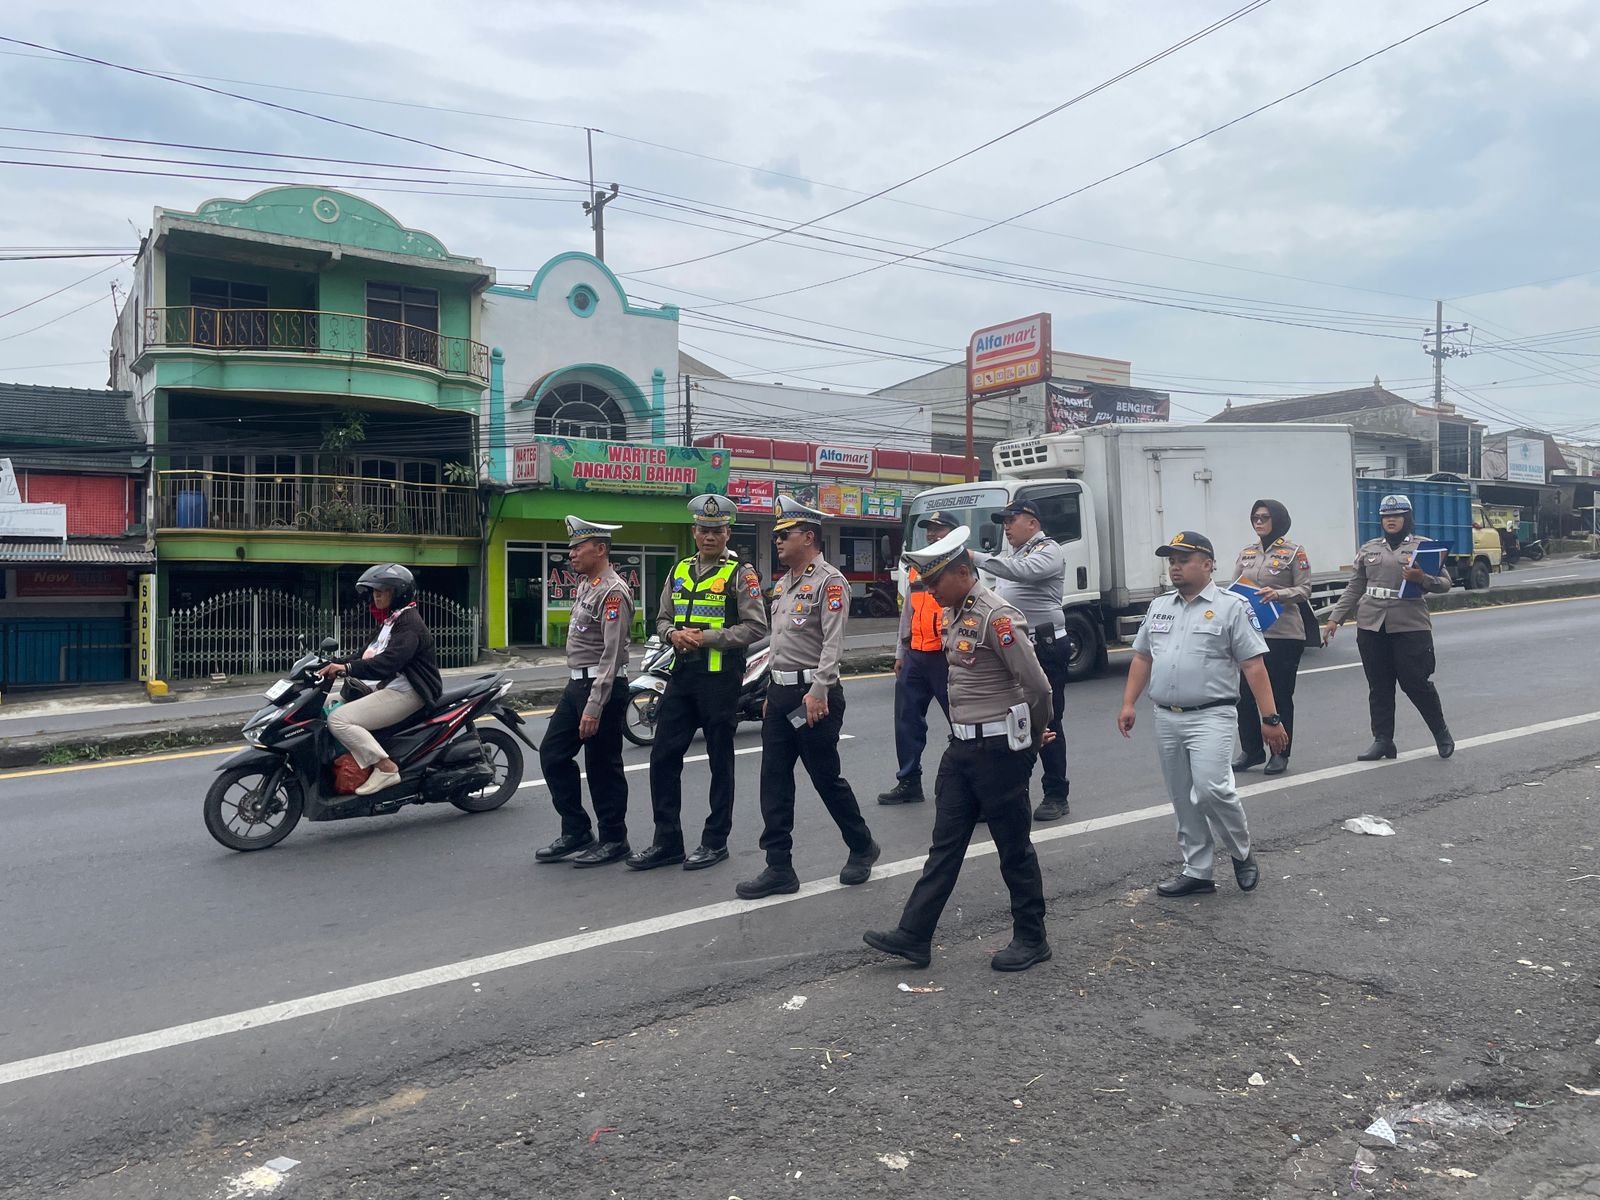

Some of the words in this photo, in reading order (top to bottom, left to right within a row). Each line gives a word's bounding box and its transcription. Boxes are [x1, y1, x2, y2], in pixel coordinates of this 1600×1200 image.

[976, 325, 1037, 353] Alfamart
[1116, 401, 1157, 415] BENGKEL
[515, 447, 537, 462] WARTEG
[607, 445, 667, 465] WARTEG
[819, 448, 870, 464] Alfamart
[524, 464, 536, 478] JAM
[572, 462, 641, 481] ANGKASA
[645, 466, 698, 484] BAHARI
[1151, 613, 1176, 621] FEBRI
[140, 584, 149, 677] SABLON
[957, 627, 978, 638] POLRI
